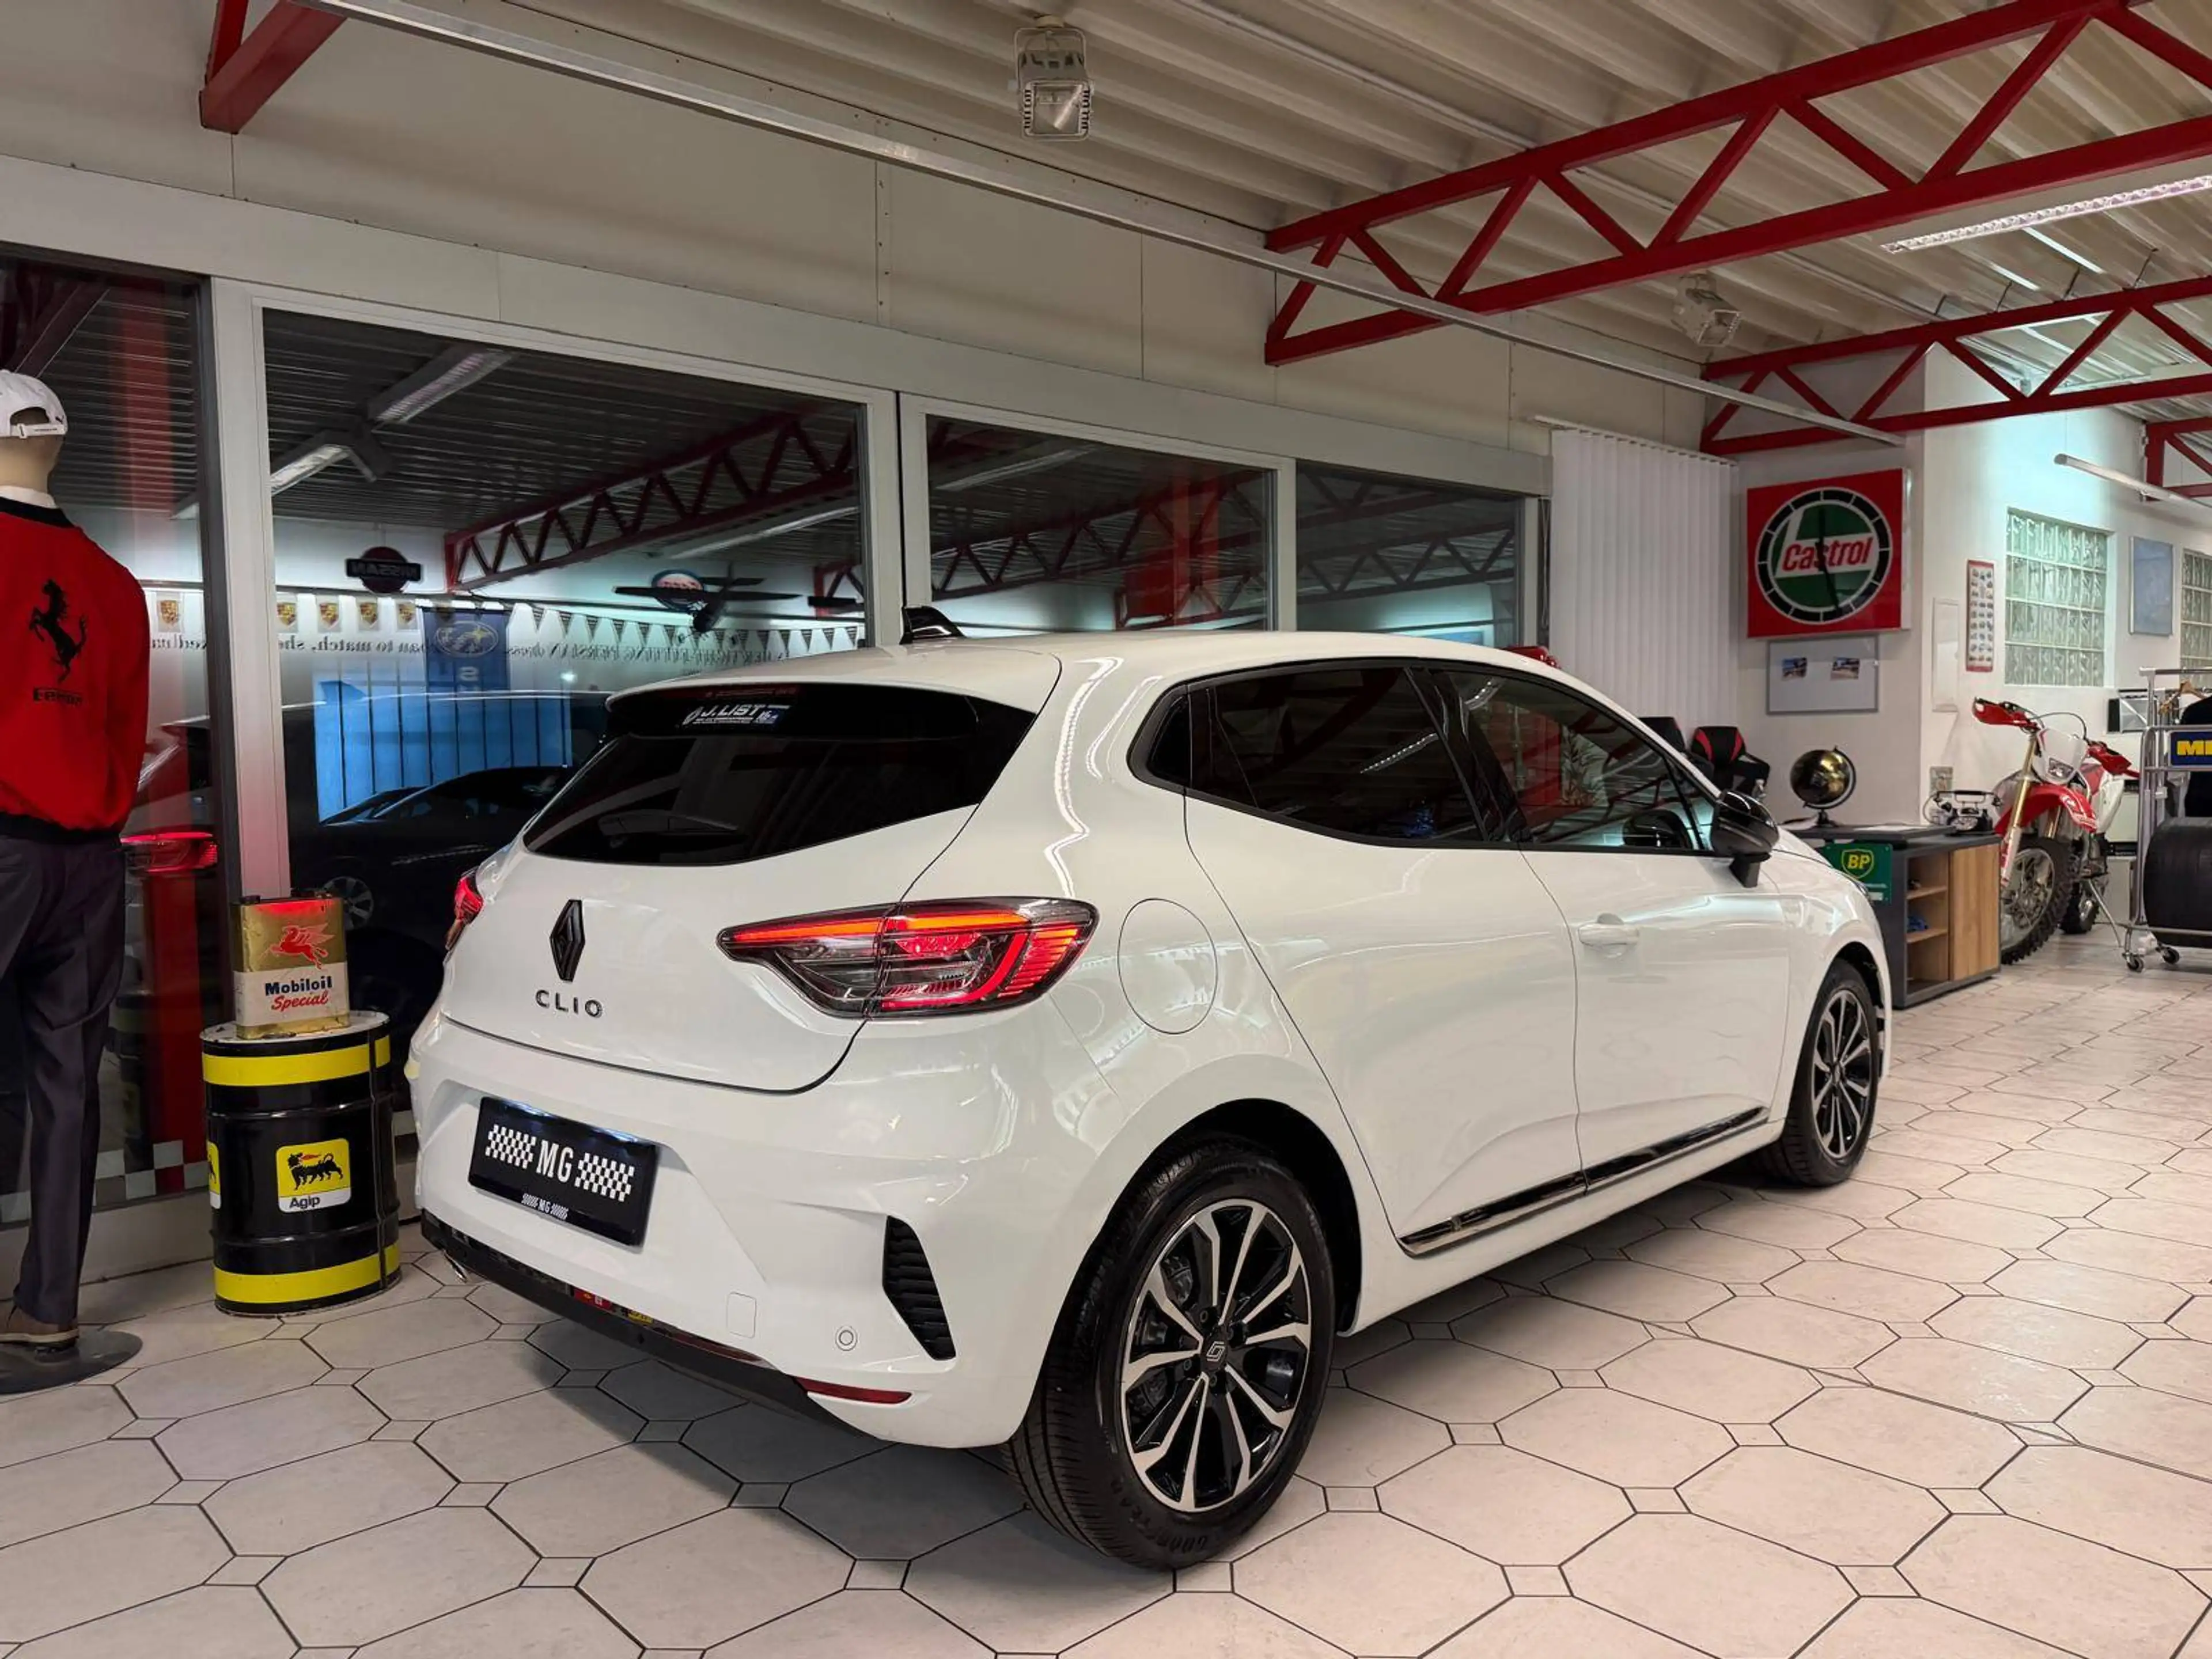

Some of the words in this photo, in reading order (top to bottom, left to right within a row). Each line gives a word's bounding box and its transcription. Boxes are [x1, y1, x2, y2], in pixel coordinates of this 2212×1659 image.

[1847, 854, 1870, 869] BP
[265, 975, 332, 996] Mobiloil
[271, 990, 329, 1013] Special
[535, 989, 603, 1018] CLIO
[536, 1139, 574, 1183] MG
[289, 1195, 320, 1210] Agip
